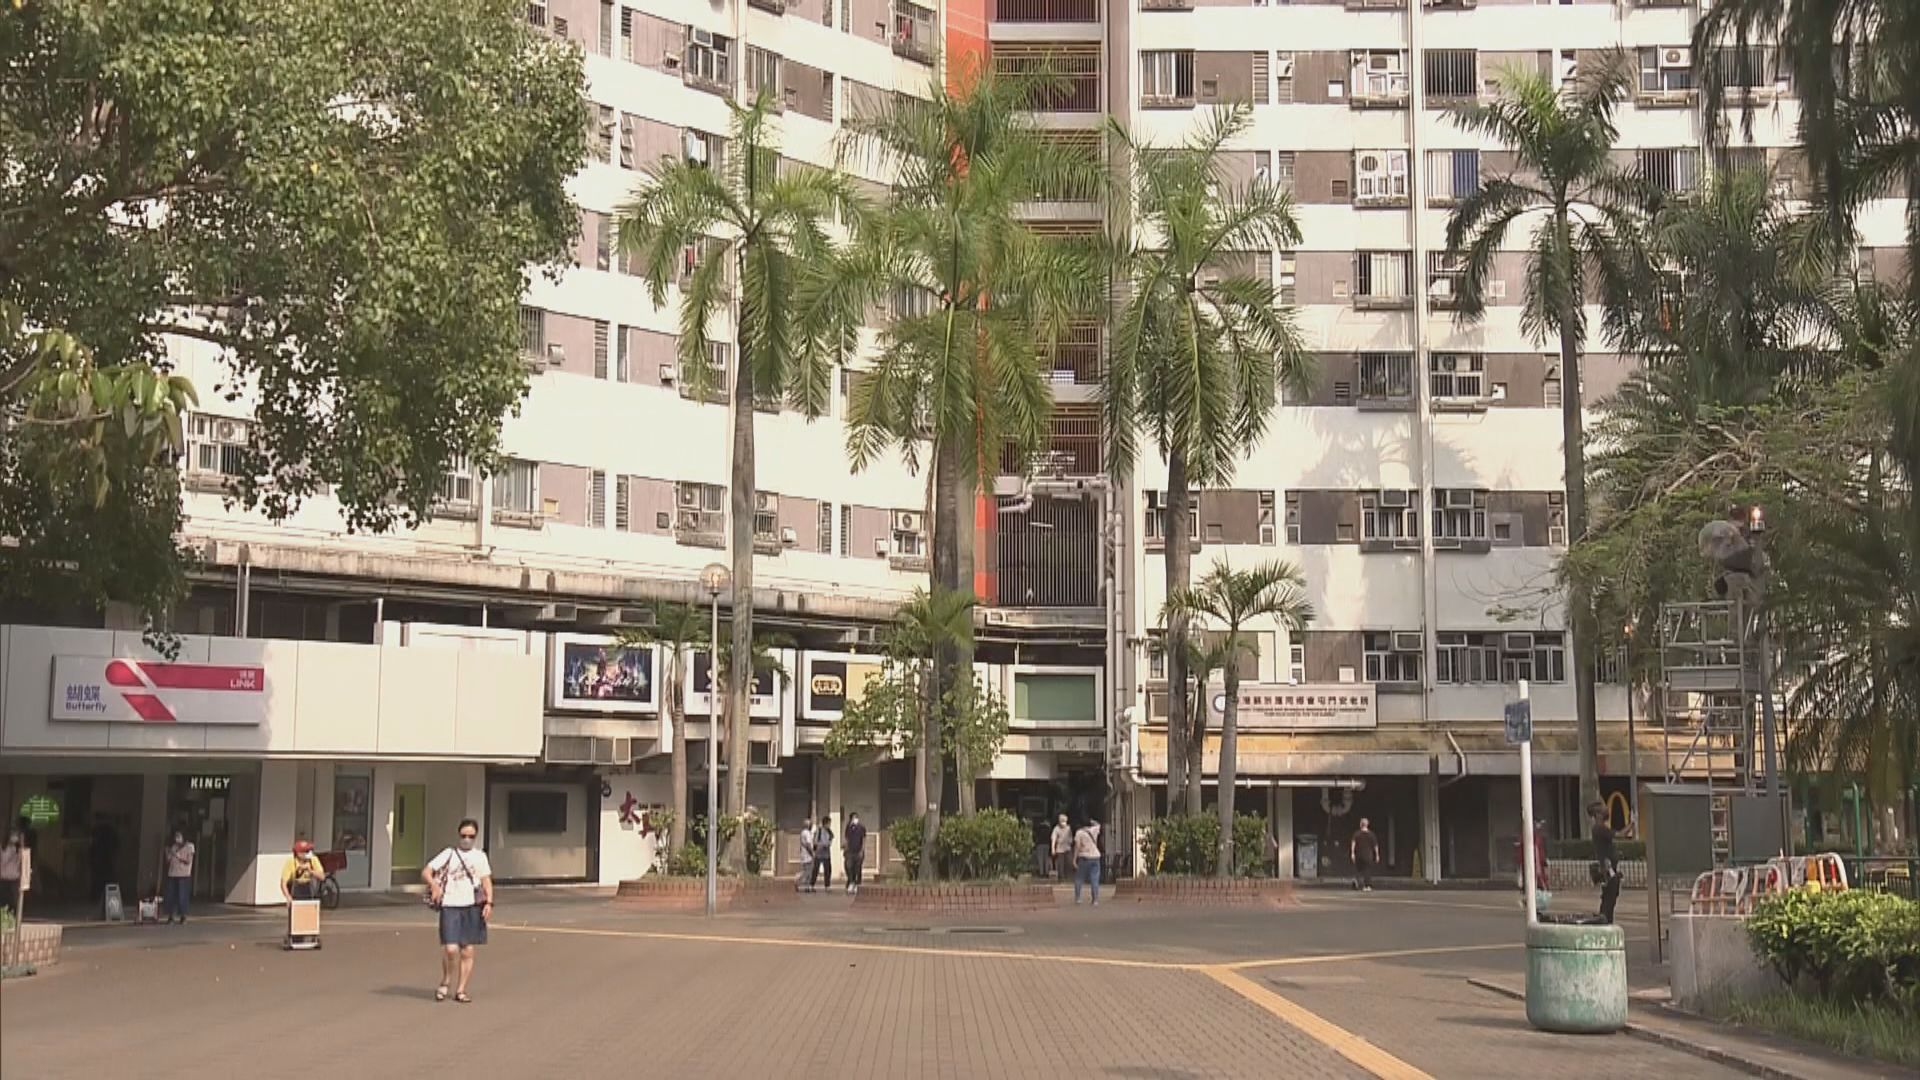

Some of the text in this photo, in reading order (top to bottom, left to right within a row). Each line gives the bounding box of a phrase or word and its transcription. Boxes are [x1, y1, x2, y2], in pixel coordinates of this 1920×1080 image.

[229, 679, 256, 688] LINK
[66, 685, 101, 701] 蝴蝶
[65, 701, 107, 713] Butterfly
[190, 777, 231, 790] KINGY
